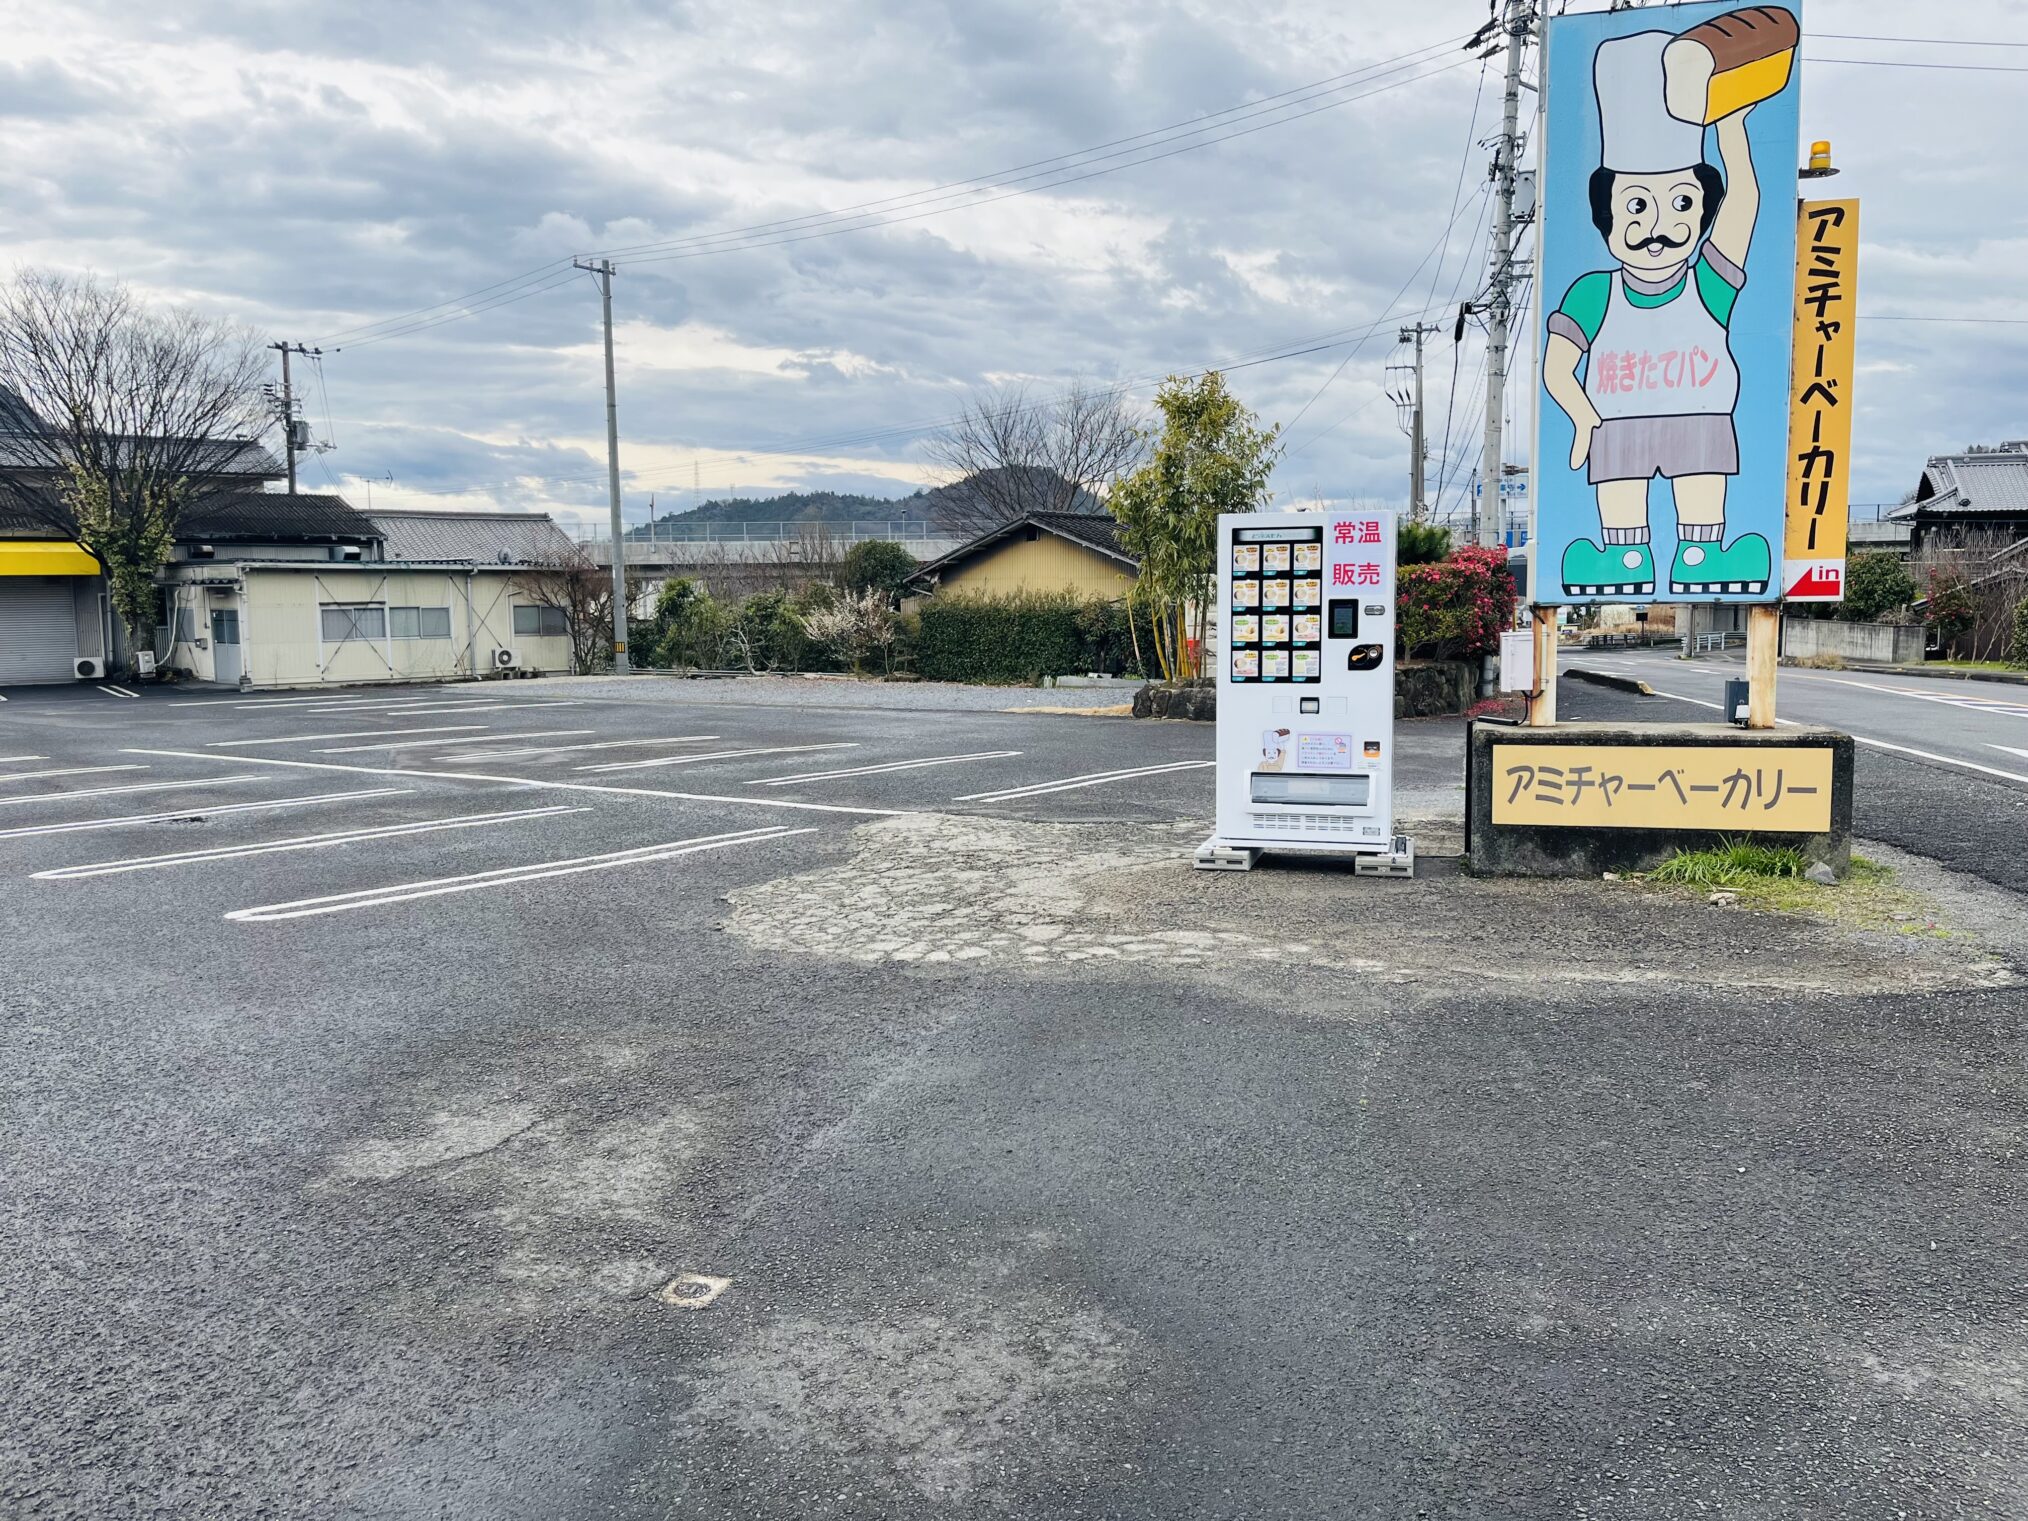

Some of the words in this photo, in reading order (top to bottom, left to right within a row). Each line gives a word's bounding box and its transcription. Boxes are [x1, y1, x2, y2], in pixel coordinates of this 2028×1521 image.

[1596, 345, 1719, 394] 焼きたてパン
[1797, 206, 1845, 551] アミチャーベーカリー
[1333, 521, 1382, 545] 常温
[1332, 562, 1381, 586] 販売
[1818, 566, 1840, 580] in
[1506, 765, 1818, 810] アミチャーベーカリー
